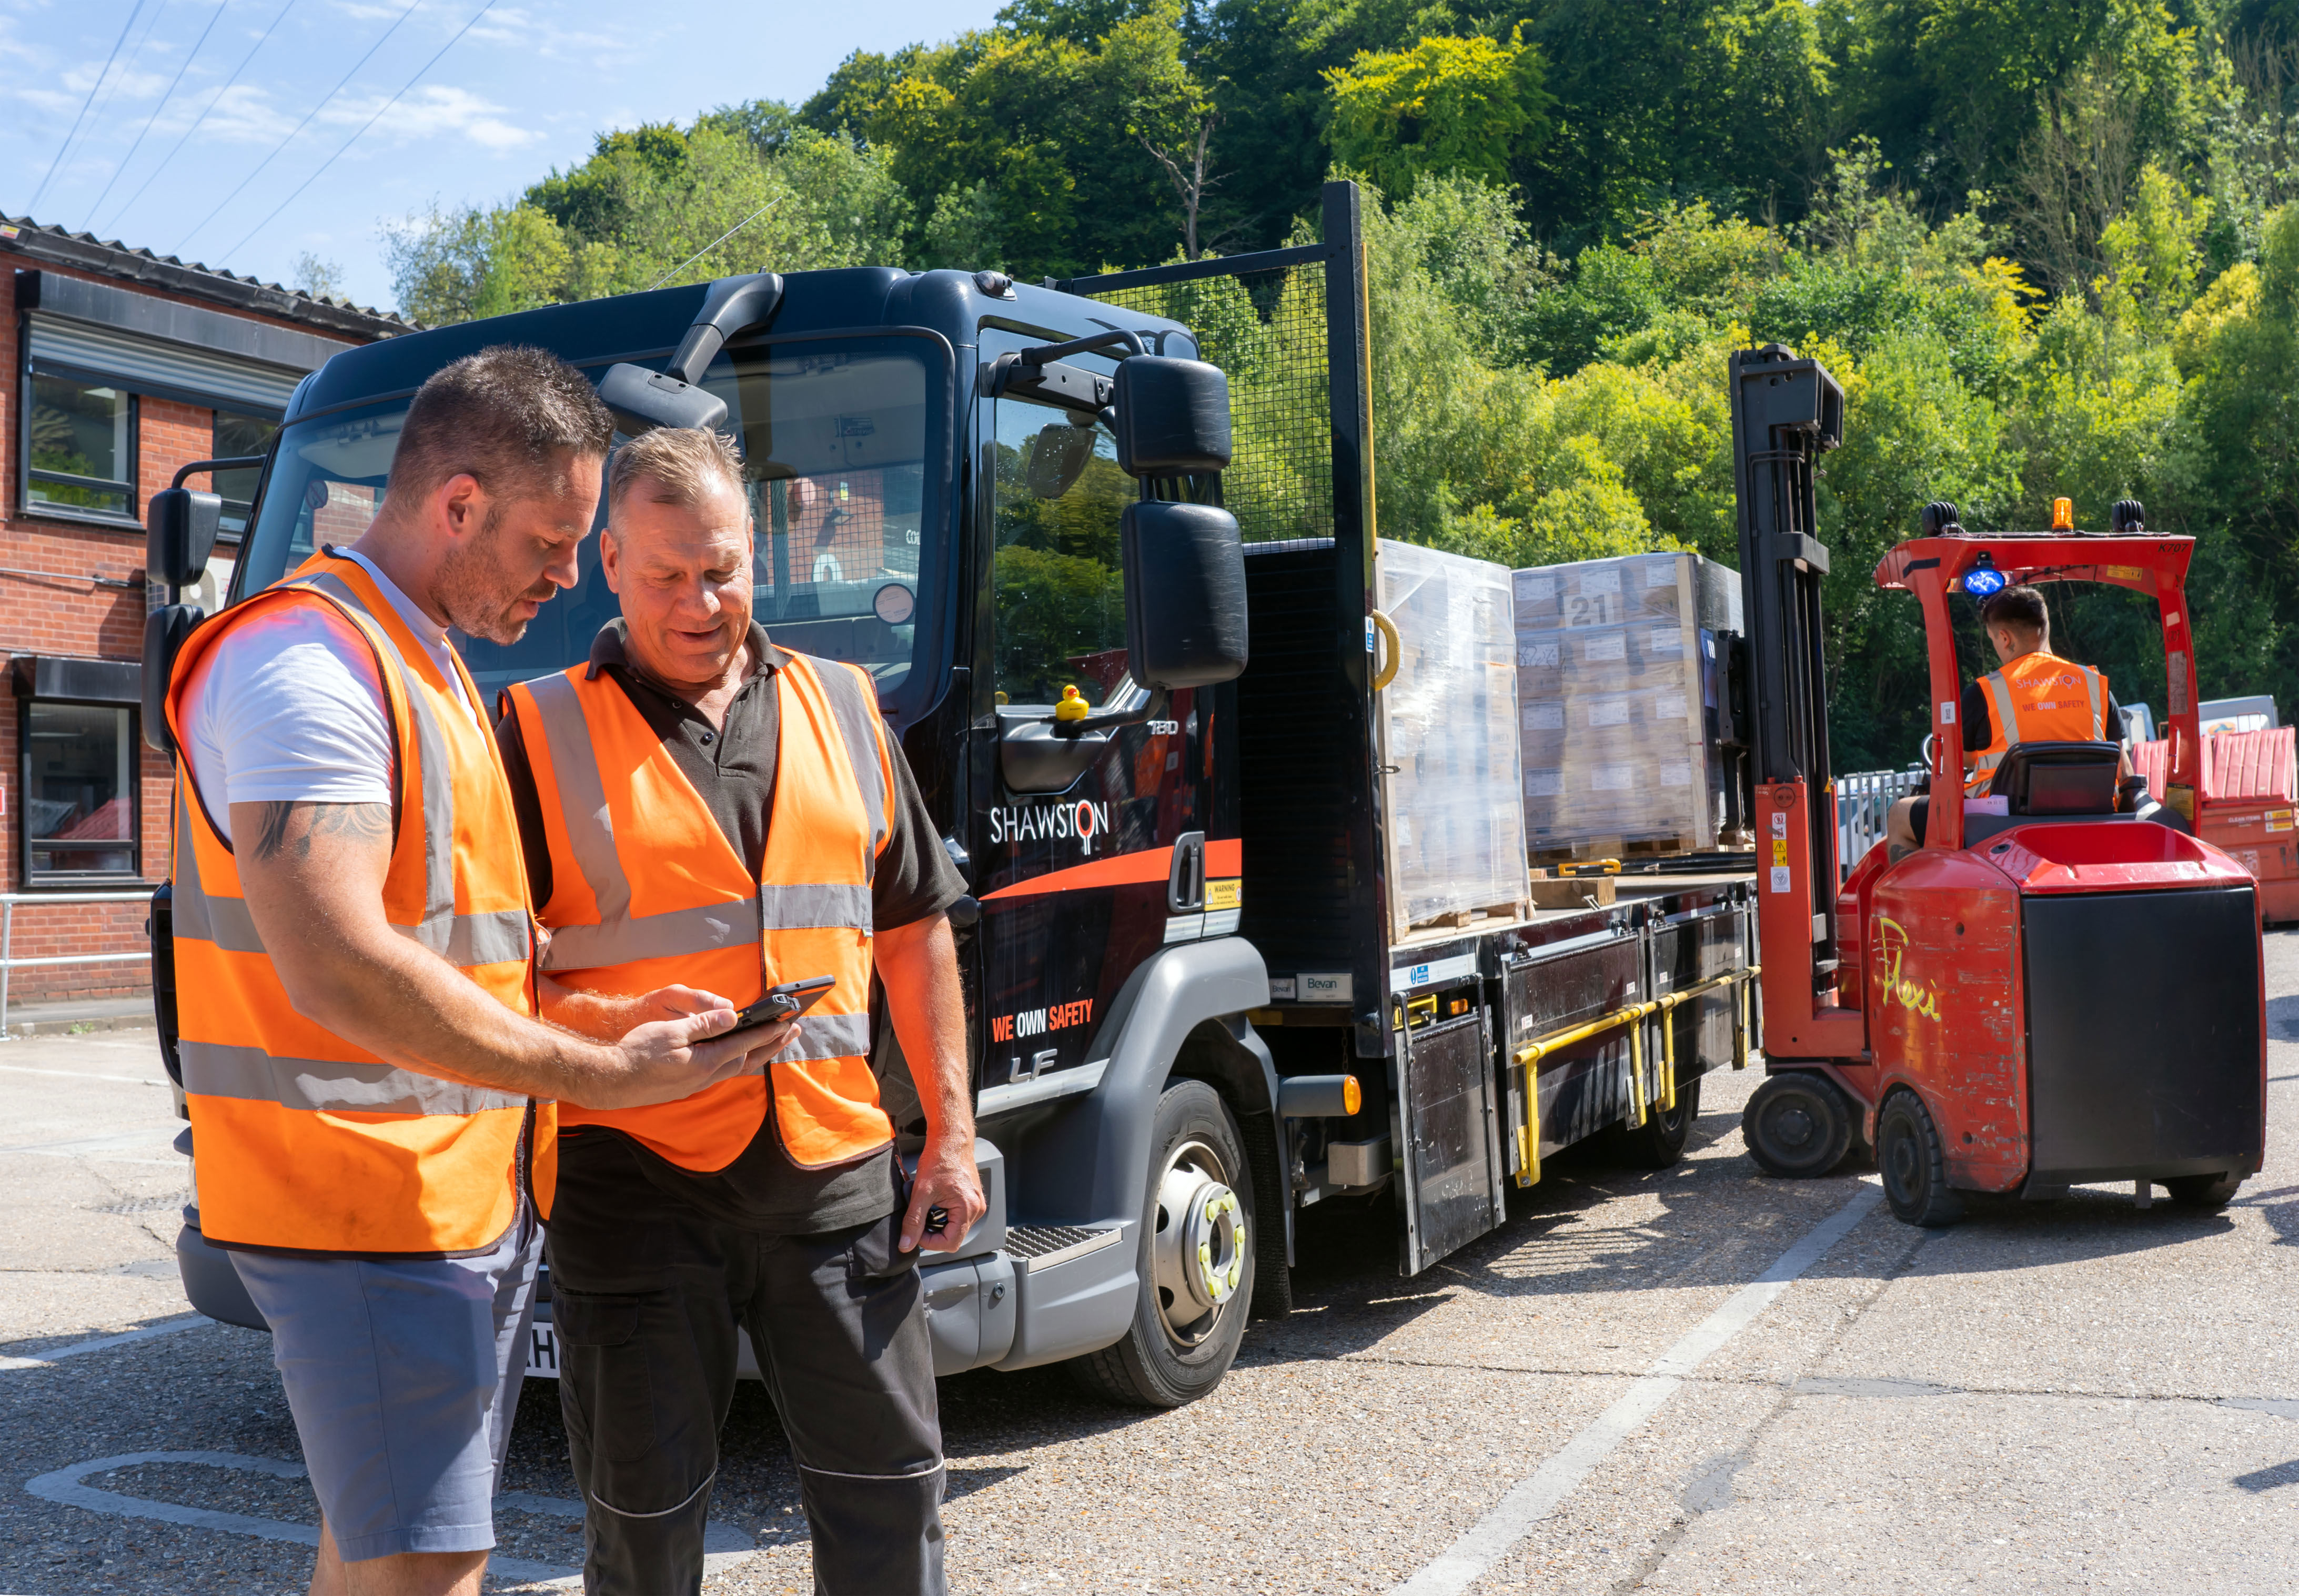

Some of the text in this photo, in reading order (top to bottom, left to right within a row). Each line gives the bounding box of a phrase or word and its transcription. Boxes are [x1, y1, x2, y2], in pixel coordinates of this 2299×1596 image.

[2158, 542, 2189, 553] K707
[1570, 594, 1606, 627] 21
[2015, 674, 2081, 690] SHAWSTON
[2022, 700, 2084, 712] WE OWN SAFETY
[990, 799, 1109, 855] SHAWSTON
[1214, 884, 1235, 893] WARNING
[1307, 977, 1337, 989] Bevan
[992, 998, 1093, 1043] WE OWN SAFETY
[1009, 1048, 1058, 1084] LF
